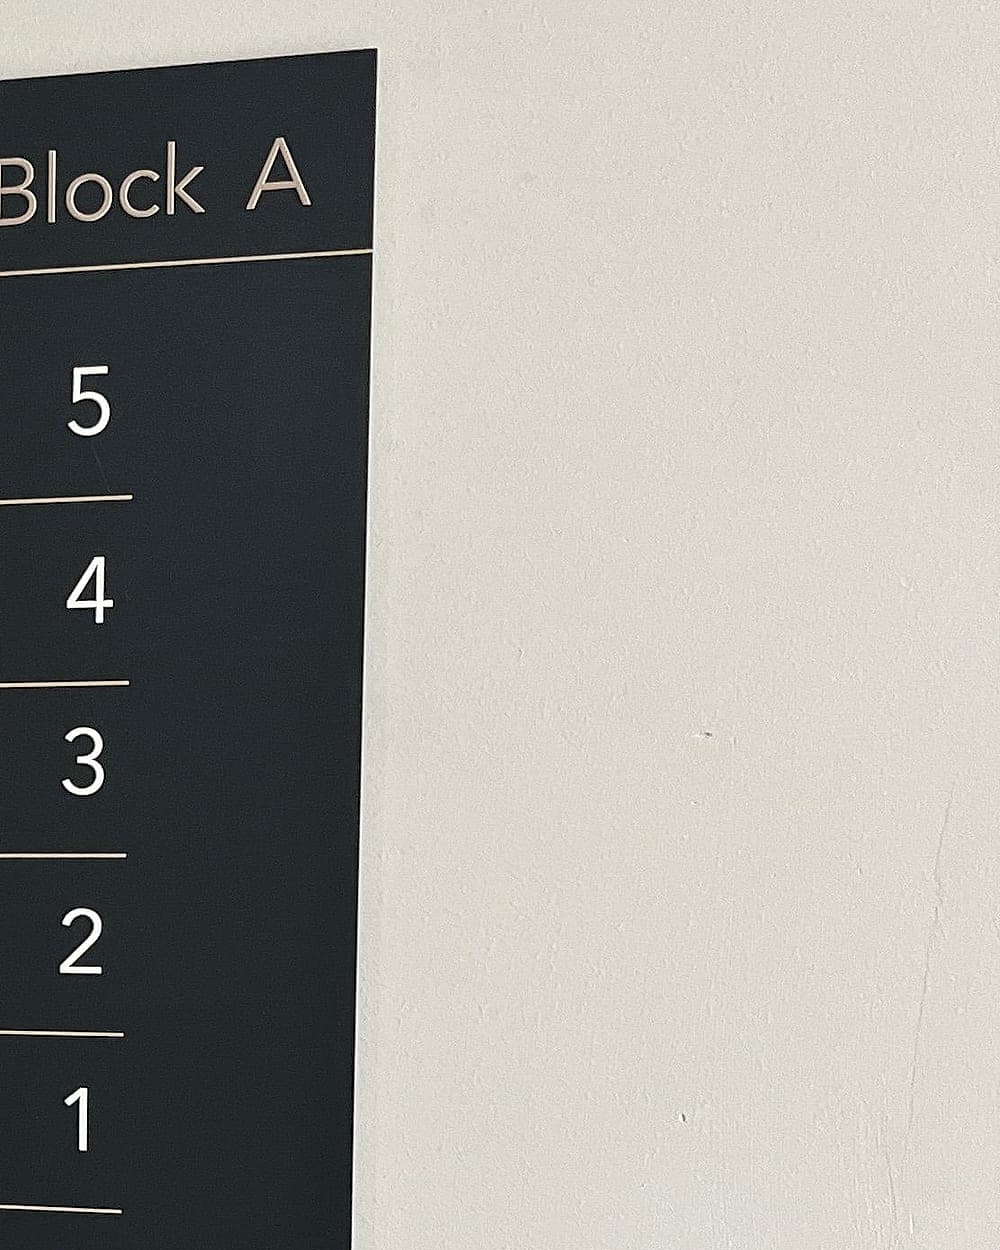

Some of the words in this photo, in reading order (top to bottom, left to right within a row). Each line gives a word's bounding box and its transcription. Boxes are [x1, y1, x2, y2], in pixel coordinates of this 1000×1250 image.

[245, 136, 312, 210] A
[67, 365, 111, 437] 5
[66, 556, 114, 624] 4
[61, 726, 105, 796] 3
[59, 907, 103, 975] 2
[64, 1086, 88, 1152] 1
